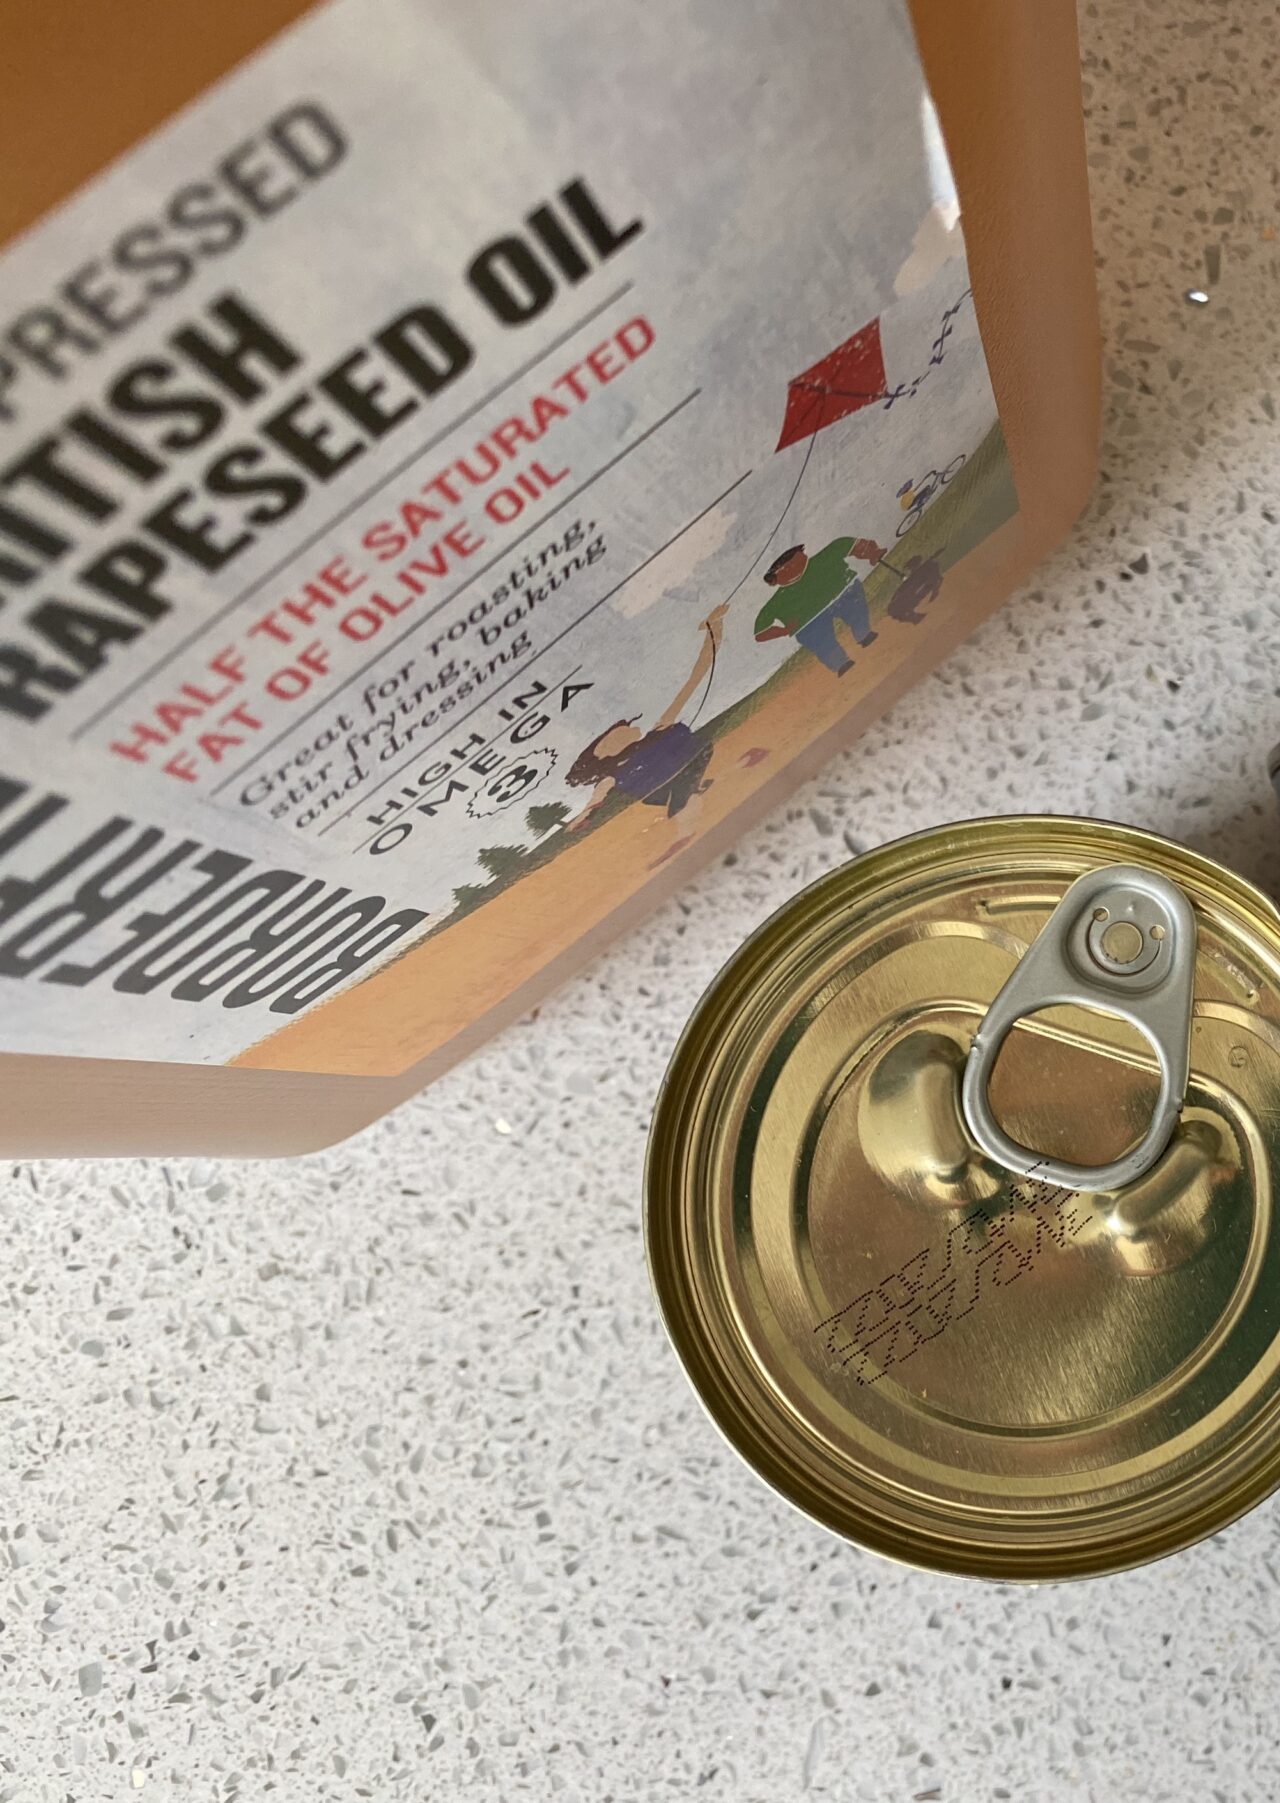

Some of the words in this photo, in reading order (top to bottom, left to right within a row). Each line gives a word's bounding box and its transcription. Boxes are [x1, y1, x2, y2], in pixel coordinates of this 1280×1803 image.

[0, 98, 349, 421] RESSED
[466, 176, 644, 330] OIL
[0, 290, 302, 588] ITISH
[109, 646, 250, 763] HALF
[248, 554, 368, 646] THE
[362, 315, 656, 562] SATURATED
[161, 701, 264, 783] FAT
[265, 642, 334, 701] OF
[339, 521, 486, 643] OLIVE
[484, 459, 571, 526] OIL
[239, 713, 353, 807] Great
[362, 659, 416, 715] for
[426, 519, 597, 657] roasting,
[269, 761, 333, 821] stir
[345, 655, 471, 764] frying,
[480, 534, 607, 648] baking
[296, 765, 369, 829] and
[378, 630, 532, 763] dressing
[367, 733, 487, 826] HIGH
[498, 680, 548, 721] IN
[369, 682, 595, 856] OMEGA
[487, 765, 538, 803] 3
